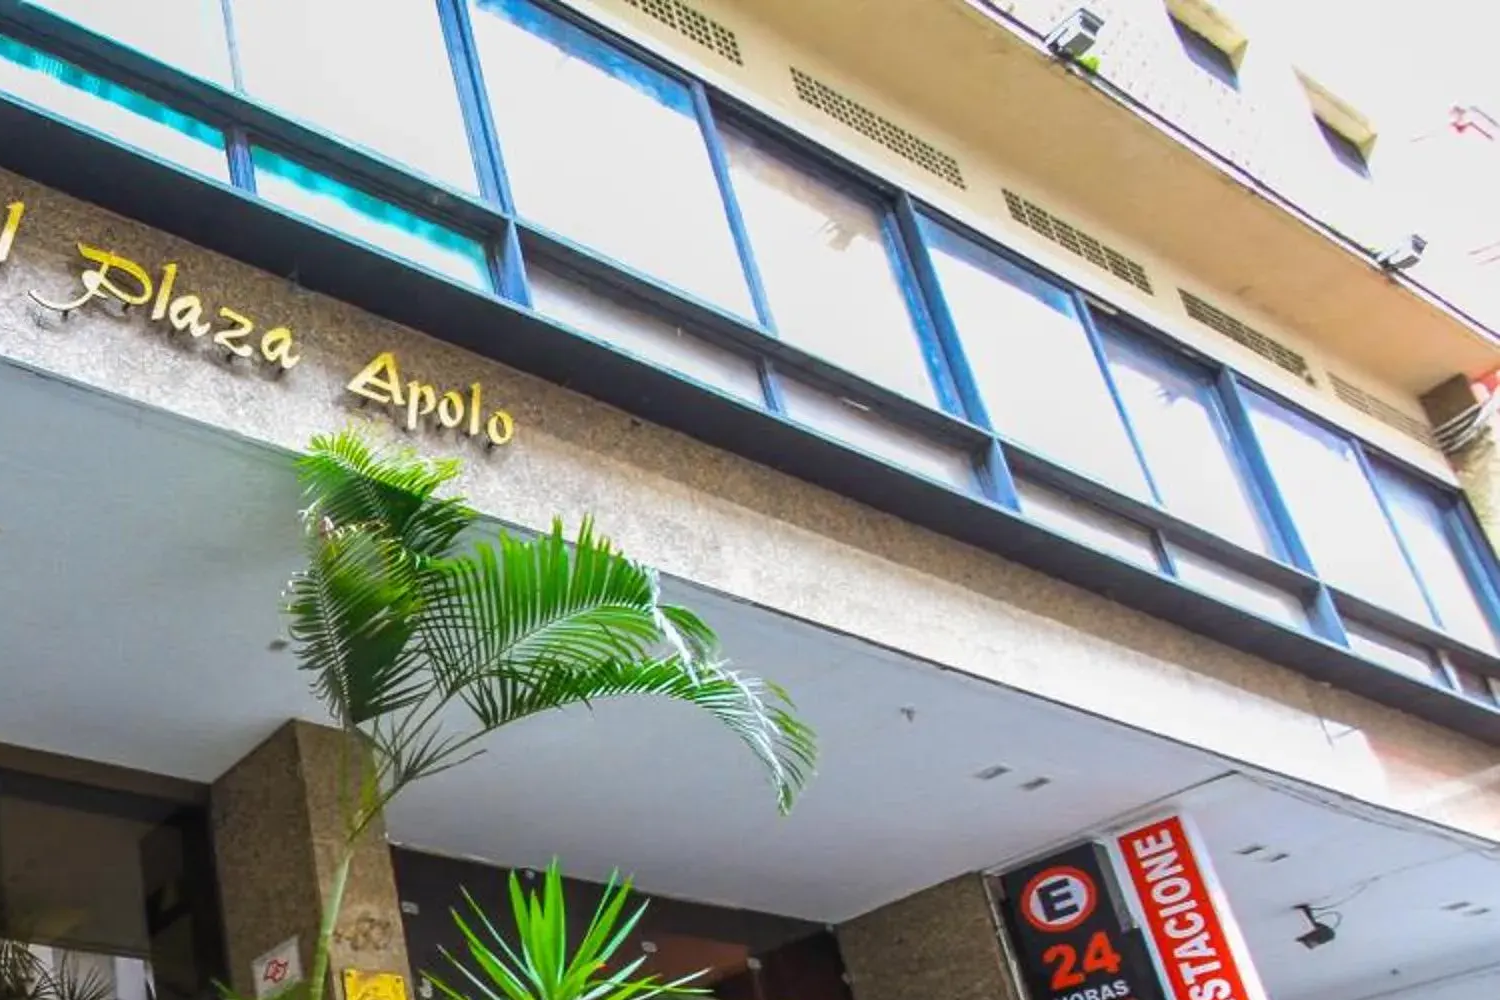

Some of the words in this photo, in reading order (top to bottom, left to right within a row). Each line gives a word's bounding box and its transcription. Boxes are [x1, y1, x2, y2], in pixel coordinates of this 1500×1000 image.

[27, 240, 300, 369] Plaza
[347, 352, 514, 445] Apolo
[1043, 931, 1121, 990] 24
